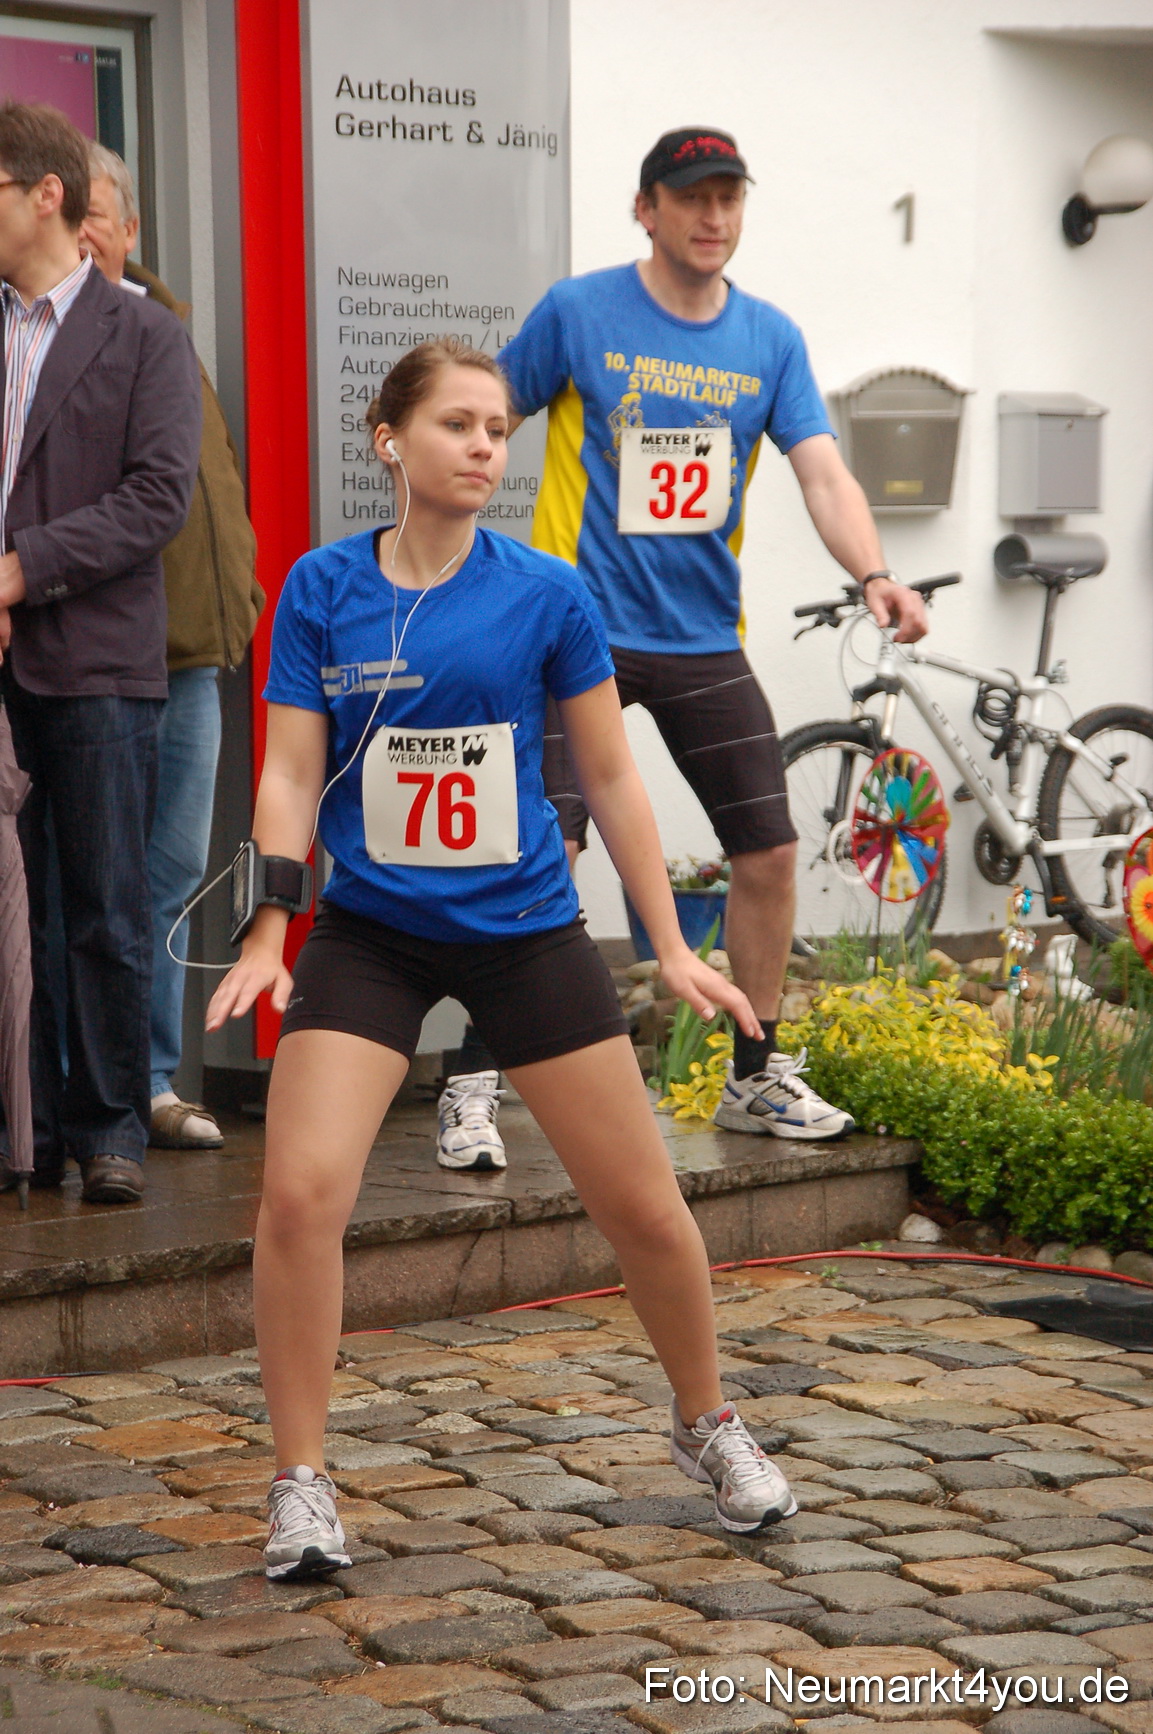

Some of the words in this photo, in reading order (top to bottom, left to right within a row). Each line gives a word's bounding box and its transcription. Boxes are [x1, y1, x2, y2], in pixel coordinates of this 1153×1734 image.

[335, 74, 476, 107] Autohaus
[335, 112, 454, 143] Gerhart
[466, 120, 485, 145] &
[498, 123, 558, 157] Jänig
[892, 191, 915, 244] 1
[337, 266, 449, 294] Neuwagen
[338, 295, 515, 325] Gebrauchtwagen
[479, 328, 490, 350] /
[340, 355, 396, 375] Auto
[604, 351, 630, 372] 10.
[633, 354, 762, 397] NEUMARKTER
[627, 372, 738, 408] STADTLAUF
[641, 433, 691, 446] MEYER
[641, 445, 691, 455] WERBUNG
[649, 459, 710, 520] 32
[387, 736, 456, 752] MEYER
[387, 752, 457, 766] WERBUNG
[397, 771, 477, 851] 76
